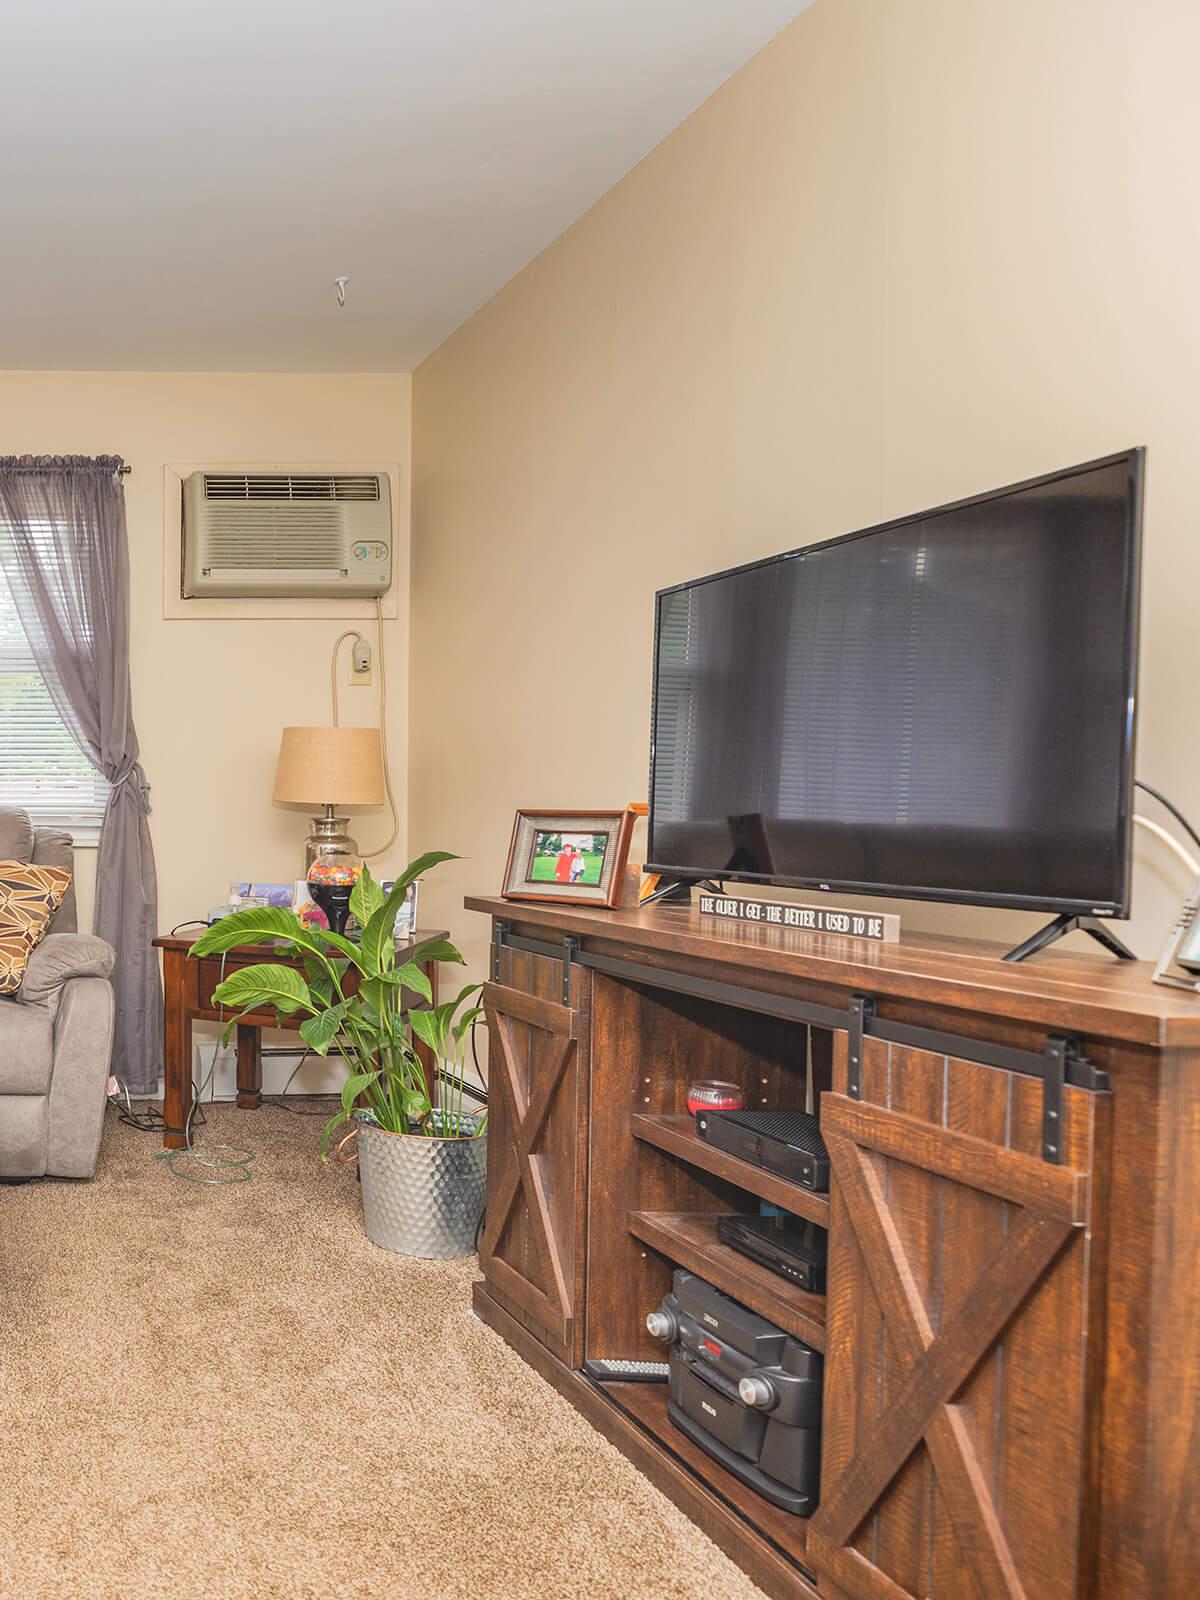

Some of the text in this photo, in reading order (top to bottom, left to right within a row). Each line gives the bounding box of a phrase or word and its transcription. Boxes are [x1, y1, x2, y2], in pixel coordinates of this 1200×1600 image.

[701, 897, 714, 913] THE
[716, 899, 738, 917] OLDER
[740, 902, 744, 917] I
[766, 906, 782, 922] THE
[784, 908, 815, 928] BETTER
[818, 912, 822, 928] I
[826, 913, 849, 932] USED
[852, 917, 864, 934] TO
[868, 918, 881, 937] BE
